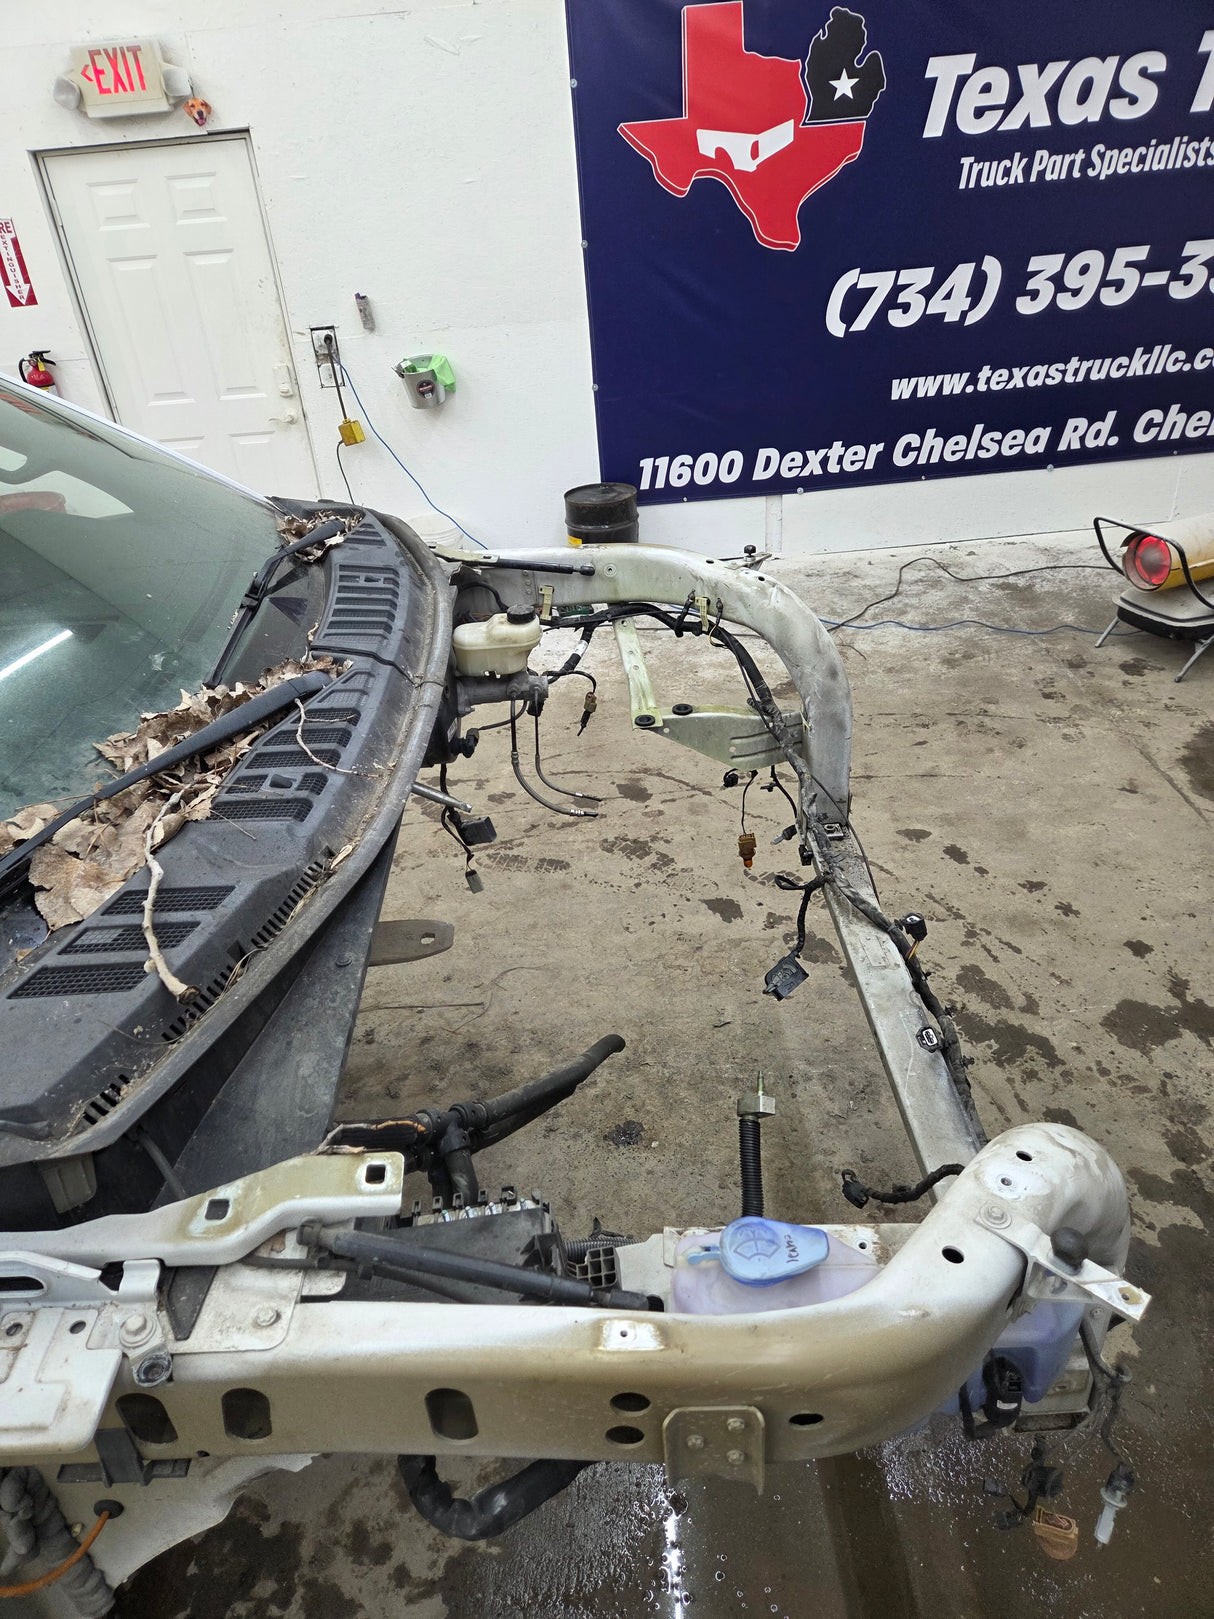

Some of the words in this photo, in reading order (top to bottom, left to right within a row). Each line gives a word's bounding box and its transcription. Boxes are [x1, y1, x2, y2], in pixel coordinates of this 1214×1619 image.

[88, 45, 147, 95] EXIT
[922, 50, 1167, 139] Texas
[958, 152, 1028, 190] Truck
[1029, 149, 1086, 183] Part
[0, 234, 25, 300] EXTINGUISHER
[825, 254, 1002, 338] (734)
[1015, 238, 1214, 315] 395-3
[890, 343, 1214, 401] www.texastruckllc.c
[639, 450, 744, 491] 11600
[752, 440, 885, 481] Dexter
[892, 423, 1052, 467] Chelsea
[1056, 410, 1119, 452] Rd.
[1133, 403, 1214, 443] Che
